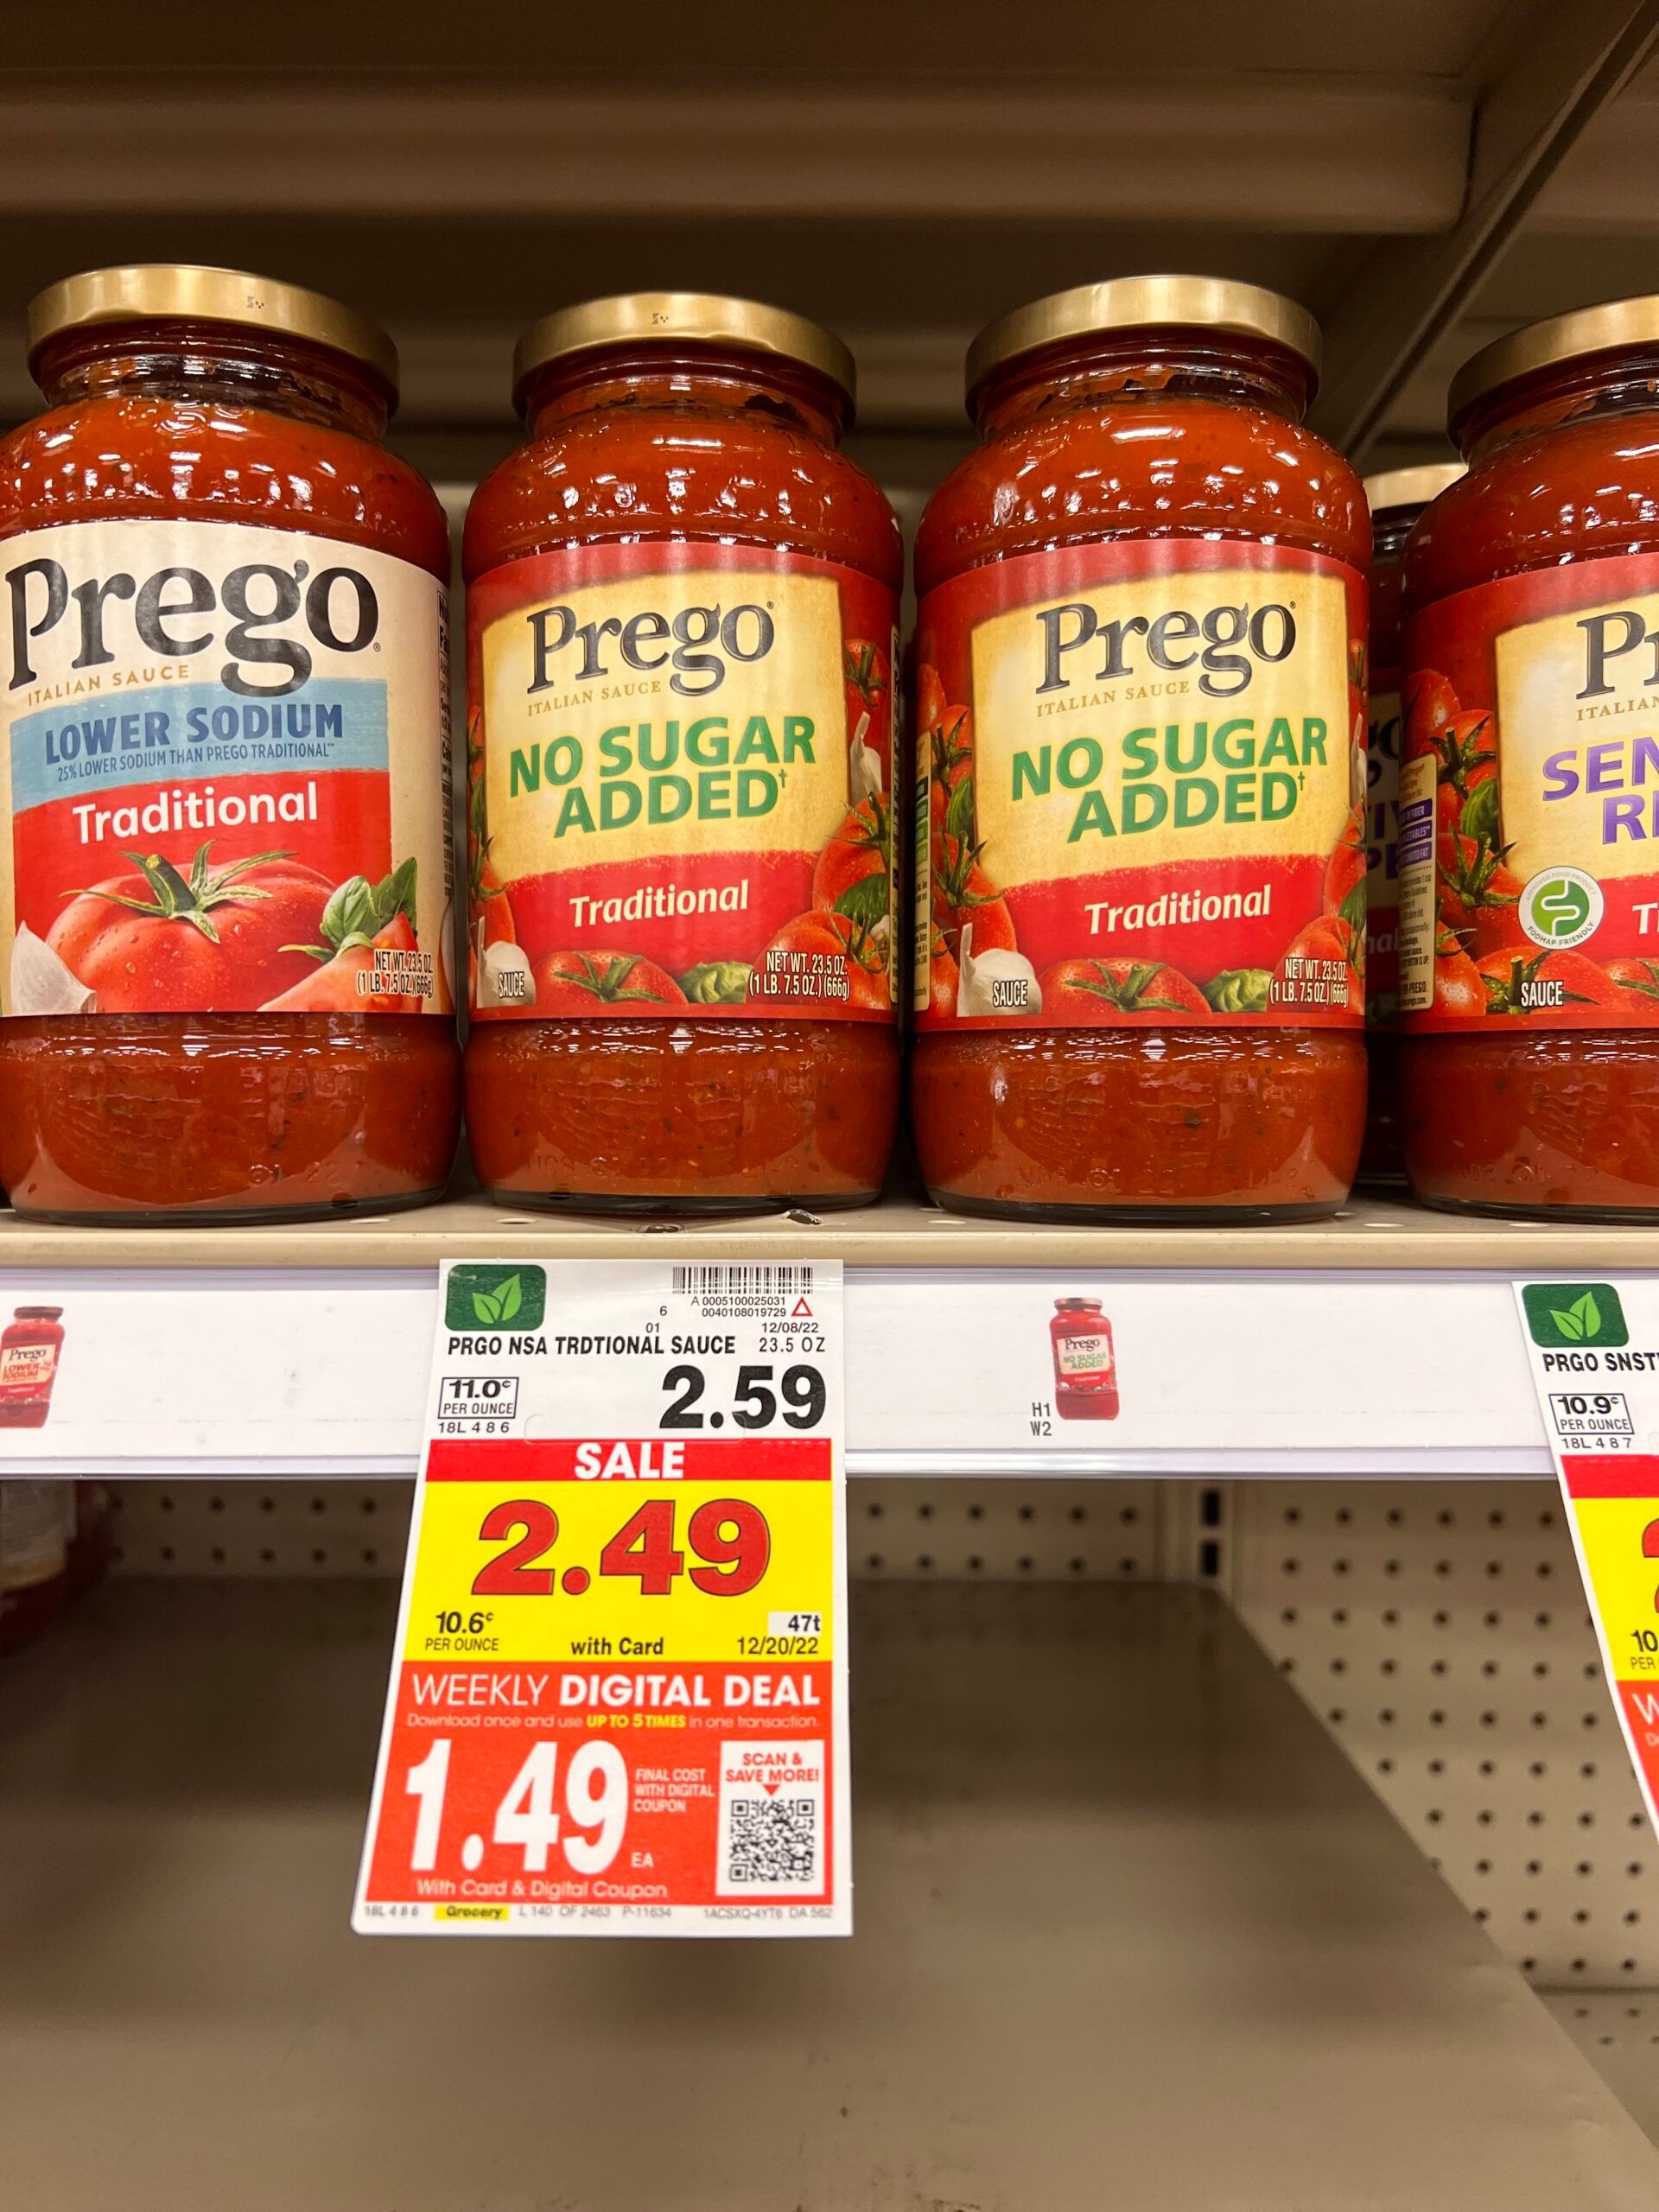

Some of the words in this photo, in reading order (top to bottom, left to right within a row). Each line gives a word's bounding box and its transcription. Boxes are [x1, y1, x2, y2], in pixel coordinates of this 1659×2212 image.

[29, 675, 101, 707] ITALIAN
[112, 664, 189, 685] SAUCE
[527, 690, 593, 716] ITALIAN
[602, 681, 661, 700] SAUCE
[1036, 690, 1116, 717] ITALIAN
[1125, 681, 1190, 701] SAUCE
[45, 711, 171, 765] LOWER
[187, 703, 343, 742] SODIUM
[57, 766, 77, 781] 25%
[79, 759, 118, 777] LOWER
[119, 751, 167, 772] SODIUM
[171, 747, 203, 765] THAN
[207, 745, 248, 761] PREGO
[510, 735, 583, 798] NO
[599, 715, 816, 777] SUGAR
[1012, 737, 1103, 802] NO
[1122, 717, 1327, 779] SUGAR
[73, 781, 318, 844] Traditional
[569, 880, 750, 927] Traditional
[1084, 884, 1271, 935] Traditional
[1527, 925, 1556, 945] FODMAP
[1559, 921, 1594, 945] FRIENDLY
[375, 950, 391, 970] NET
[408, 952, 423, 973] 23.5
[766, 951, 788, 972] NET
[790, 952, 810, 973] WT.
[812, 954, 831, 974] 23.5
[834, 955, 847, 975] OZ.
[1285, 958, 1304, 979] NET
[1305, 959, 1320, 980] WT.
[1322, 960, 1338, 981] 23.5
[370, 973, 384, 992] LB.
[386, 974, 398, 993] 7.5
[498, 971, 524, 998] SAUCE
[749, 971, 760, 996] (1
[764, 974, 781, 995] LB.
[784, 975, 799, 995] 7.5
[802, 974, 822, 998] OZ.)
[823, 975, 849, 1001] (666g)
[1269, 979, 1279, 1004] (1
[1281, 982, 1298, 1001] LB.
[1300, 982, 1313, 1002] 7.5
[992, 979, 1028, 1007] SAUCE
[1521, 981, 1563, 1007] SAUCE
[702, 1296, 785, 1306] 0005100025031
[659, 1306, 668, 1317] 6
[702, 1307, 786, 1318] 0040108019729
[645, 1323, 660, 1333] 01
[761, 1323, 819, 1333] 12/08/22
[448, 1336, 503, 1355] PRGO
[508, 1336, 548, 1355] NSA
[555, 1336, 664, 1355] TRDTIONAL
[671, 1336, 736, 1355] SAUCE
[759, 1337, 794, 1353] 23.5
[1065, 1338, 1100, 1351] Prego
[10, 1348, 47, 1362] Prego
[1542, 1352, 1599, 1372] PRGO
[1605, 1352, 1659, 1371] SNST
[658, 1364, 827, 1430] 2.59
[443, 1403, 467, 1414] PER
[472, 1402, 513, 1414] OUNCE
[1032, 1402, 1051, 1417] H1
[438, 1421, 467, 1433] 18L
[471, 1421, 480, 1433] 4
[486, 1421, 495, 1433] 8
[500, 1421, 510, 1433] 6
[1030, 1421, 1052, 1436] W2
[1560, 1419, 1585, 1430] PER
[1589, 1419, 1630, 1430] OUNCE
[1561, 1437, 1591, 1449] 18L
[1596, 1437, 1605, 1449] 4
[1611, 1437, 1619, 1449] 8
[1624, 1437, 1632, 1449] 7
[575, 1442, 685, 1479] SALE
[471, 1497, 771, 1597] 2.49
[787, 1614, 821, 1632] 47t
[424, 1637, 453, 1651] PER
[455, 1637, 499, 1651] OUNCE
[571, 1637, 612, 1656] with
[619, 1637, 664, 1656] Card
[737, 1637, 819, 1655] 12/20/22
[1630, 1656, 1656, 1669] PER
[411, 1674, 549, 1706] WEEKLY
[559, 1675, 711, 1707] DIGITAL
[723, 1675, 820, 1706] DEAL
[407, 1713, 481, 1727] Download
[484, 1716, 521, 1728] once
[524, 1713, 555, 1728] and
[558, 1717, 583, 1728] use
[586, 1714, 607, 1728] UP
[608, 1714, 629, 1728] TO
[632, 1713, 644, 1727] 5
[645, 1714, 686, 1727] TIMES
[690, 1714, 702, 1728] in
[706, 1718, 734, 1728] one
[737, 1714, 820, 1728] transaction.
[743, 1752, 787, 1766] SCAN
[792, 1752, 803, 1765] &
[635, 1769, 671, 1782] FINAL
[672, 1769, 706, 1782] COST
[725, 1769, 763, 1783] SAVE
[769, 1768, 819, 1782] MORE!
[634, 1783, 666, 1797] WITH
[668, 1783, 715, 1797] DIGITAL
[405, 1738, 629, 1875] 1.49
[631, 1852, 654, 1867] EA
[633, 1799, 686, 1813] COUPON
[416, 1878, 456, 1896] With
[461, 1878, 507, 1897] Card
[512, 1880, 525, 1896] &
[531, 1879, 588, 1900] Digital
[592, 1881, 668, 1899] Coupon
[446, 1904, 503, 1919] Grocery
